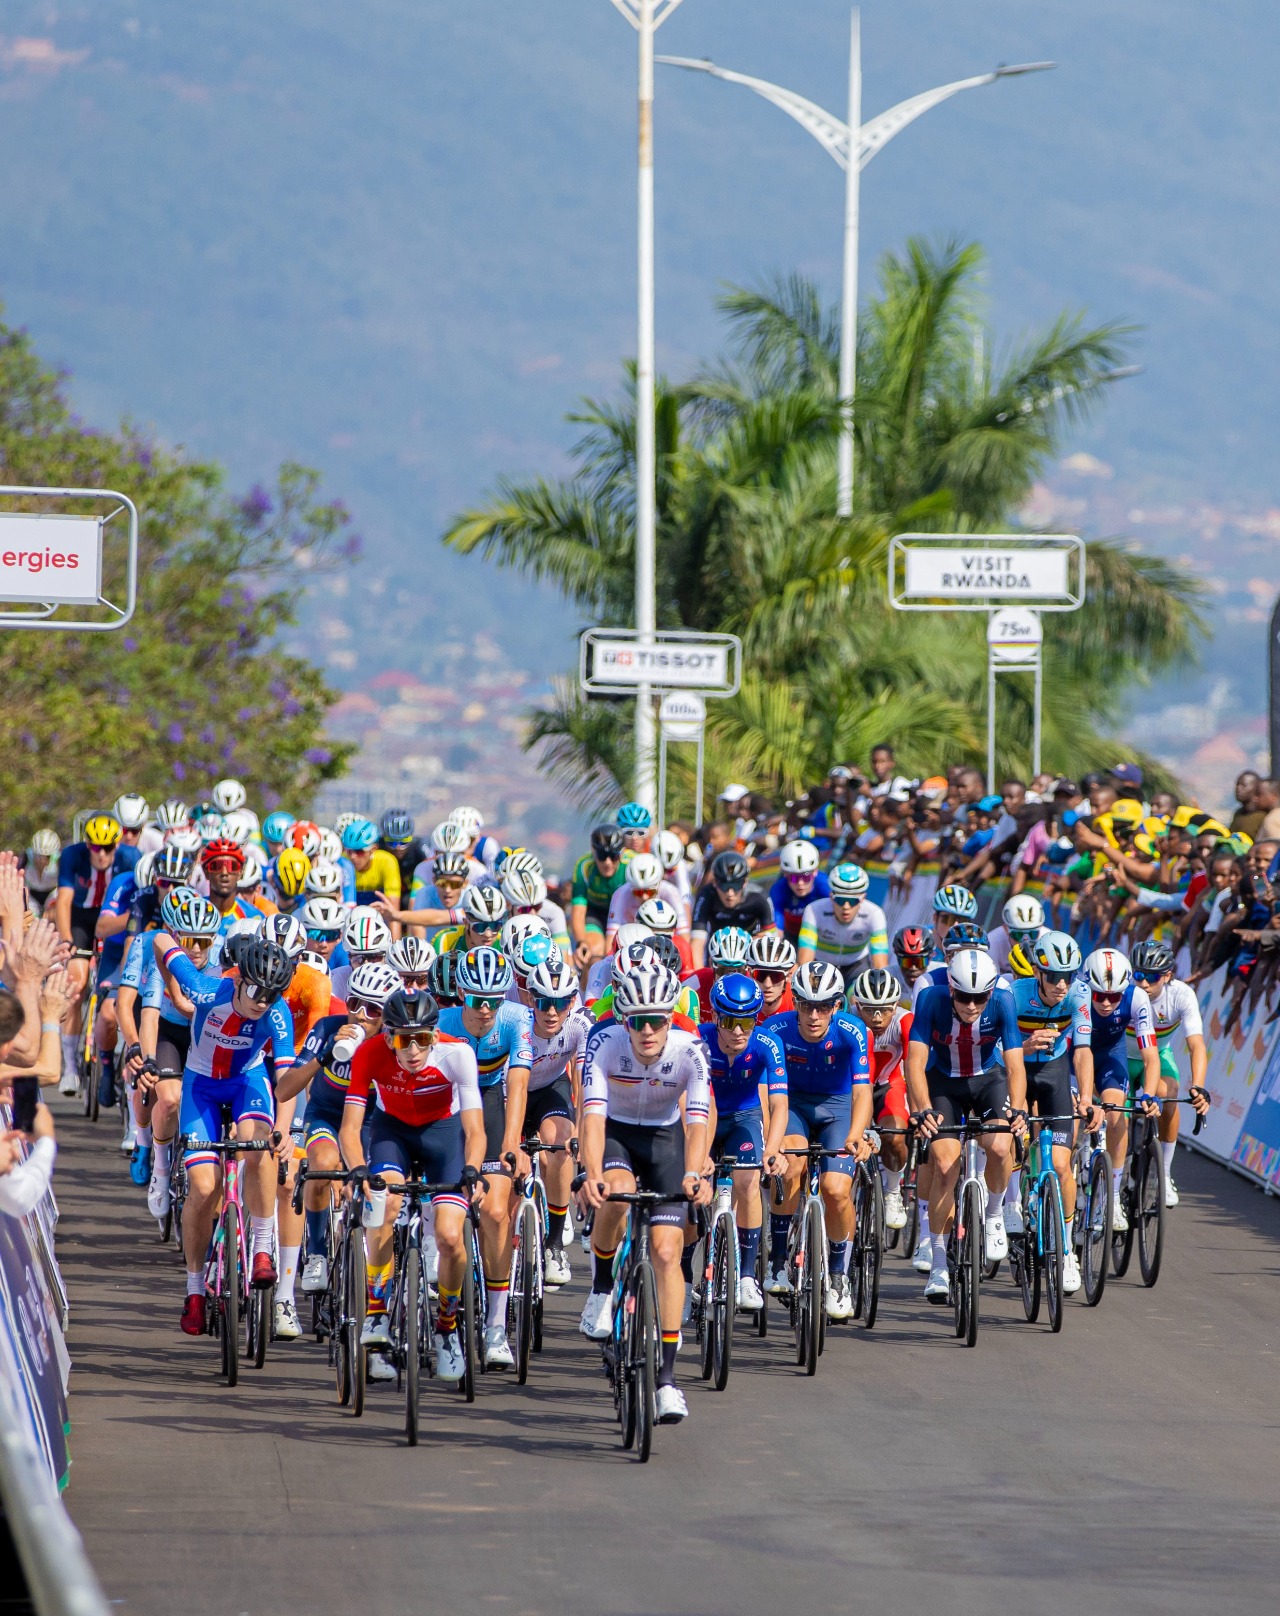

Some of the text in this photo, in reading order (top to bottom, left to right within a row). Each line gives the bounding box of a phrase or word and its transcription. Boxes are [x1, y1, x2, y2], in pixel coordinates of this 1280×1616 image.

[961, 556, 1015, 571] VISIT
[941, 573, 1032, 588] RWANDA
[637, 651, 718, 668] TISSOT
